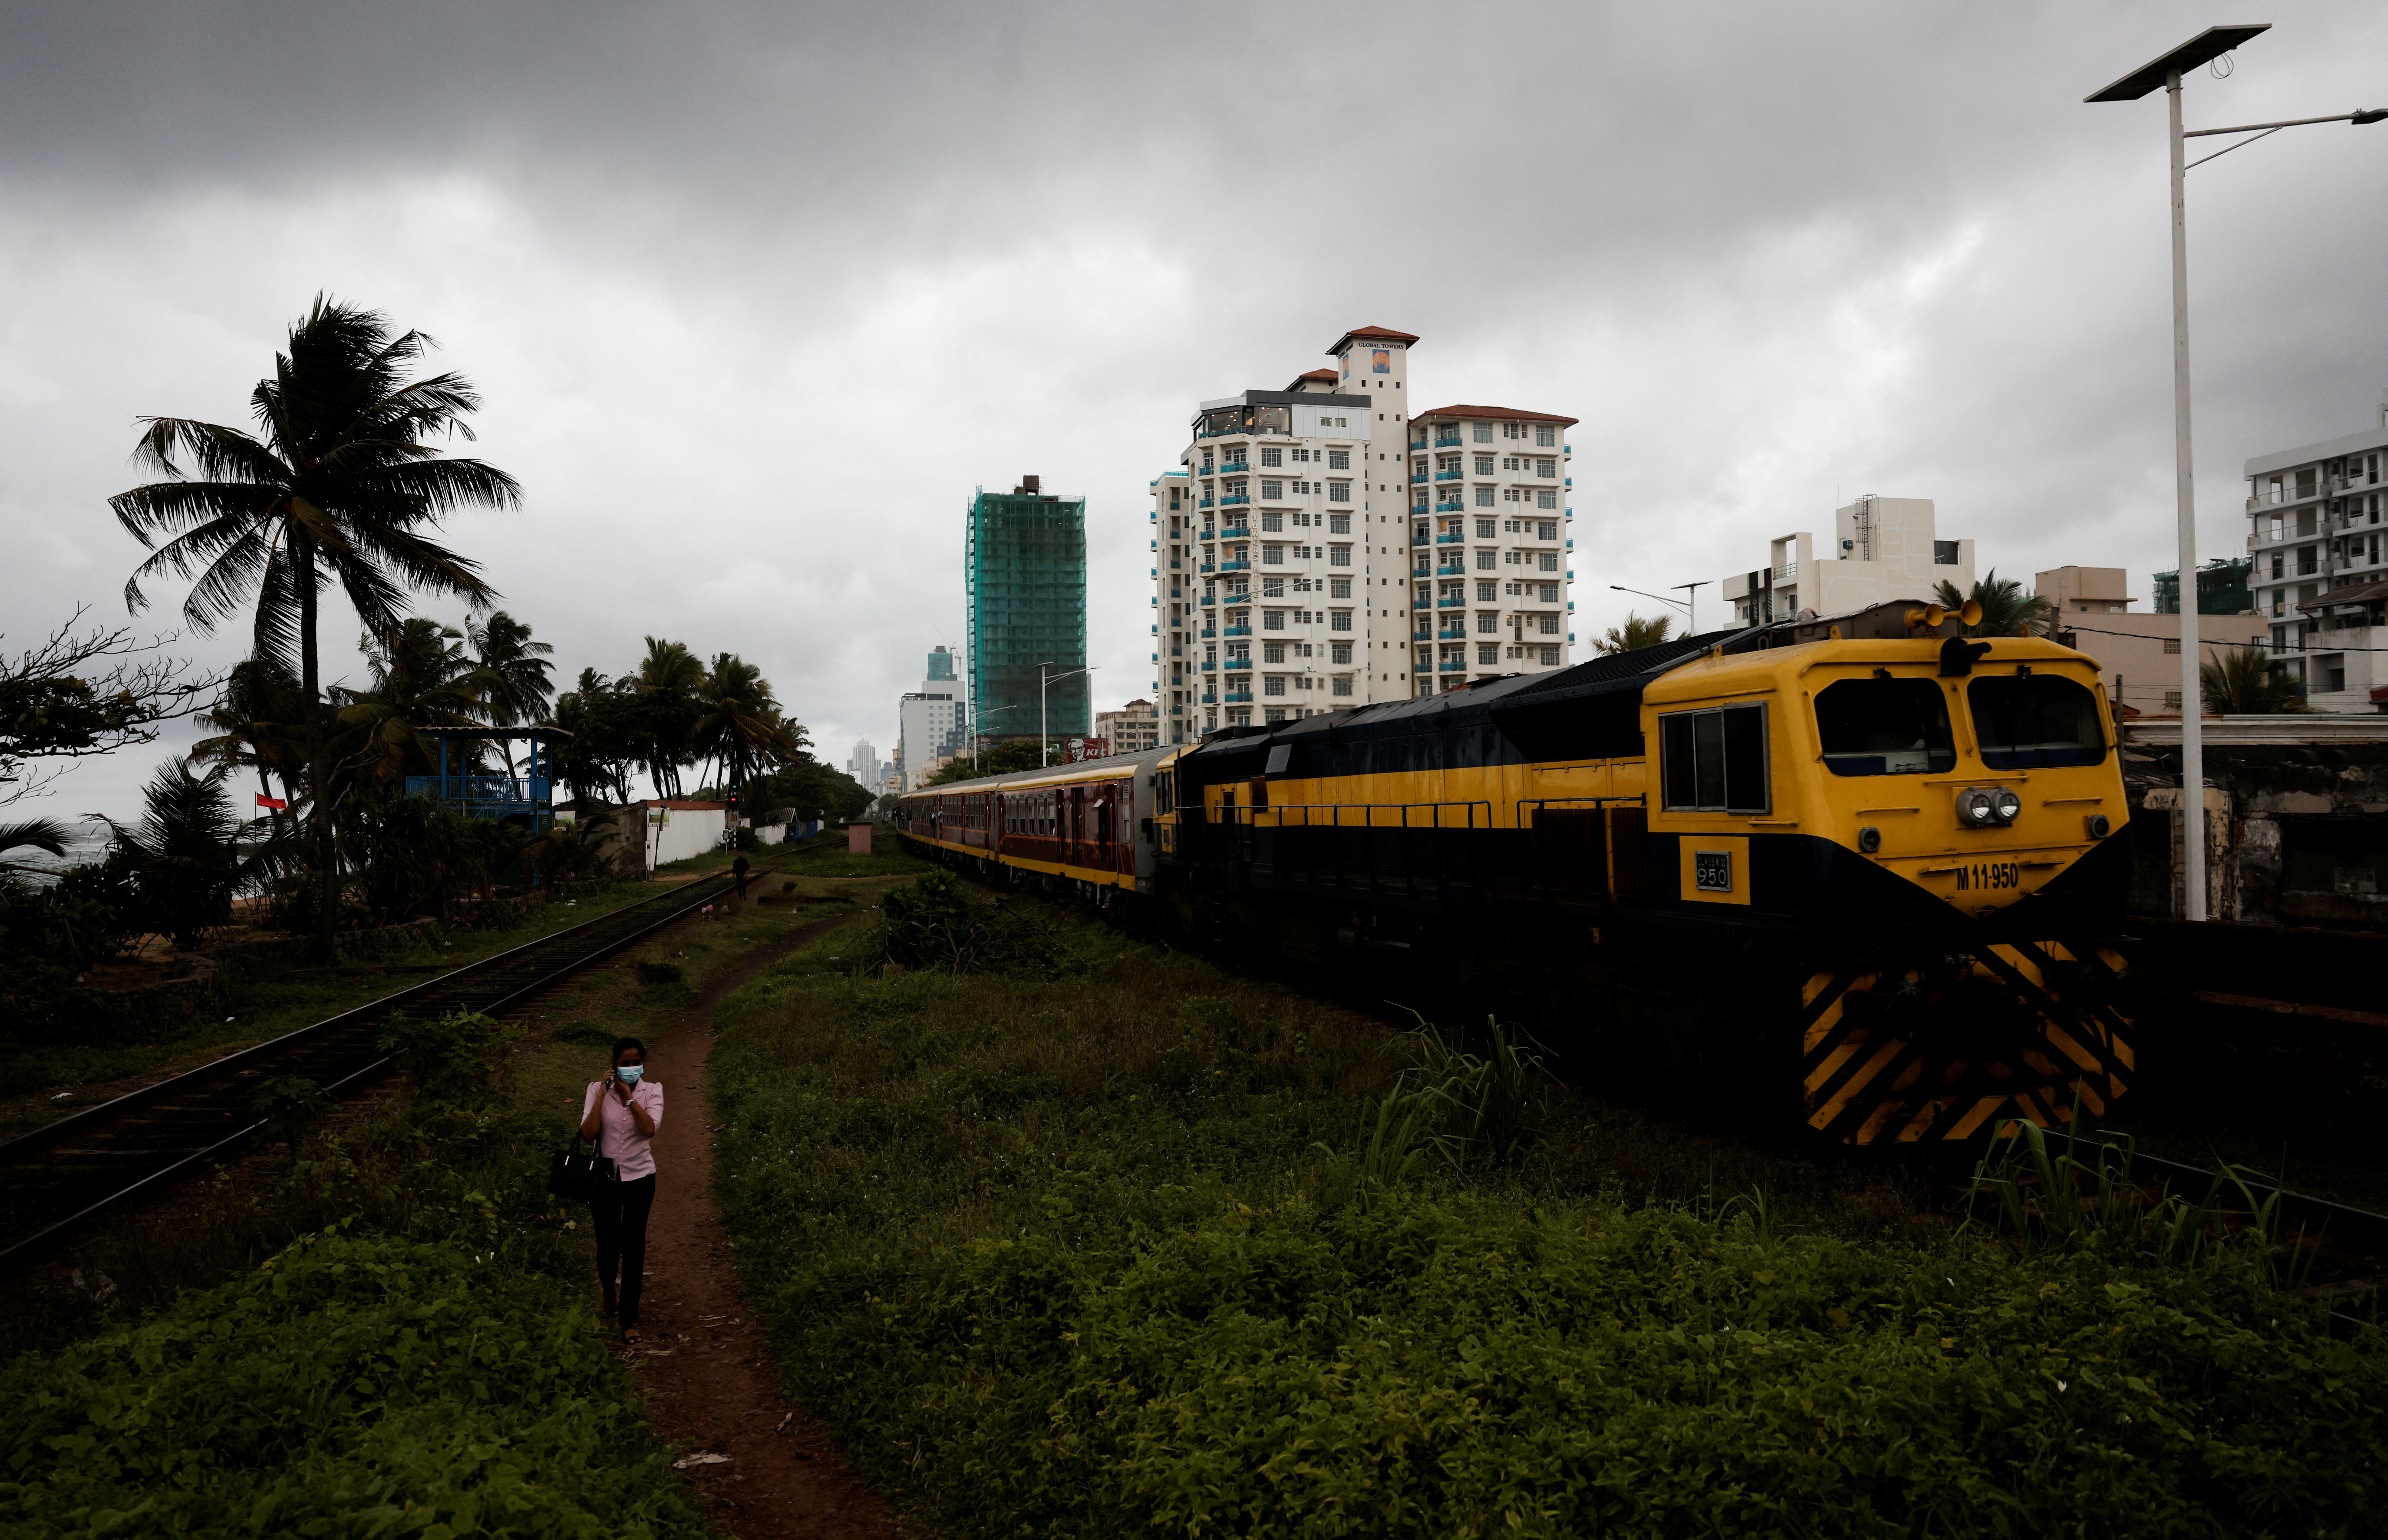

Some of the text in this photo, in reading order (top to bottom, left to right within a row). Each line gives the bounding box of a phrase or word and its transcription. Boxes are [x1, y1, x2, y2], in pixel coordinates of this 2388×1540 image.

[1698, 857, 1715, 866] CLASS
[1697, 868, 1726, 884] 950
[1956, 865, 1969, 890] M
